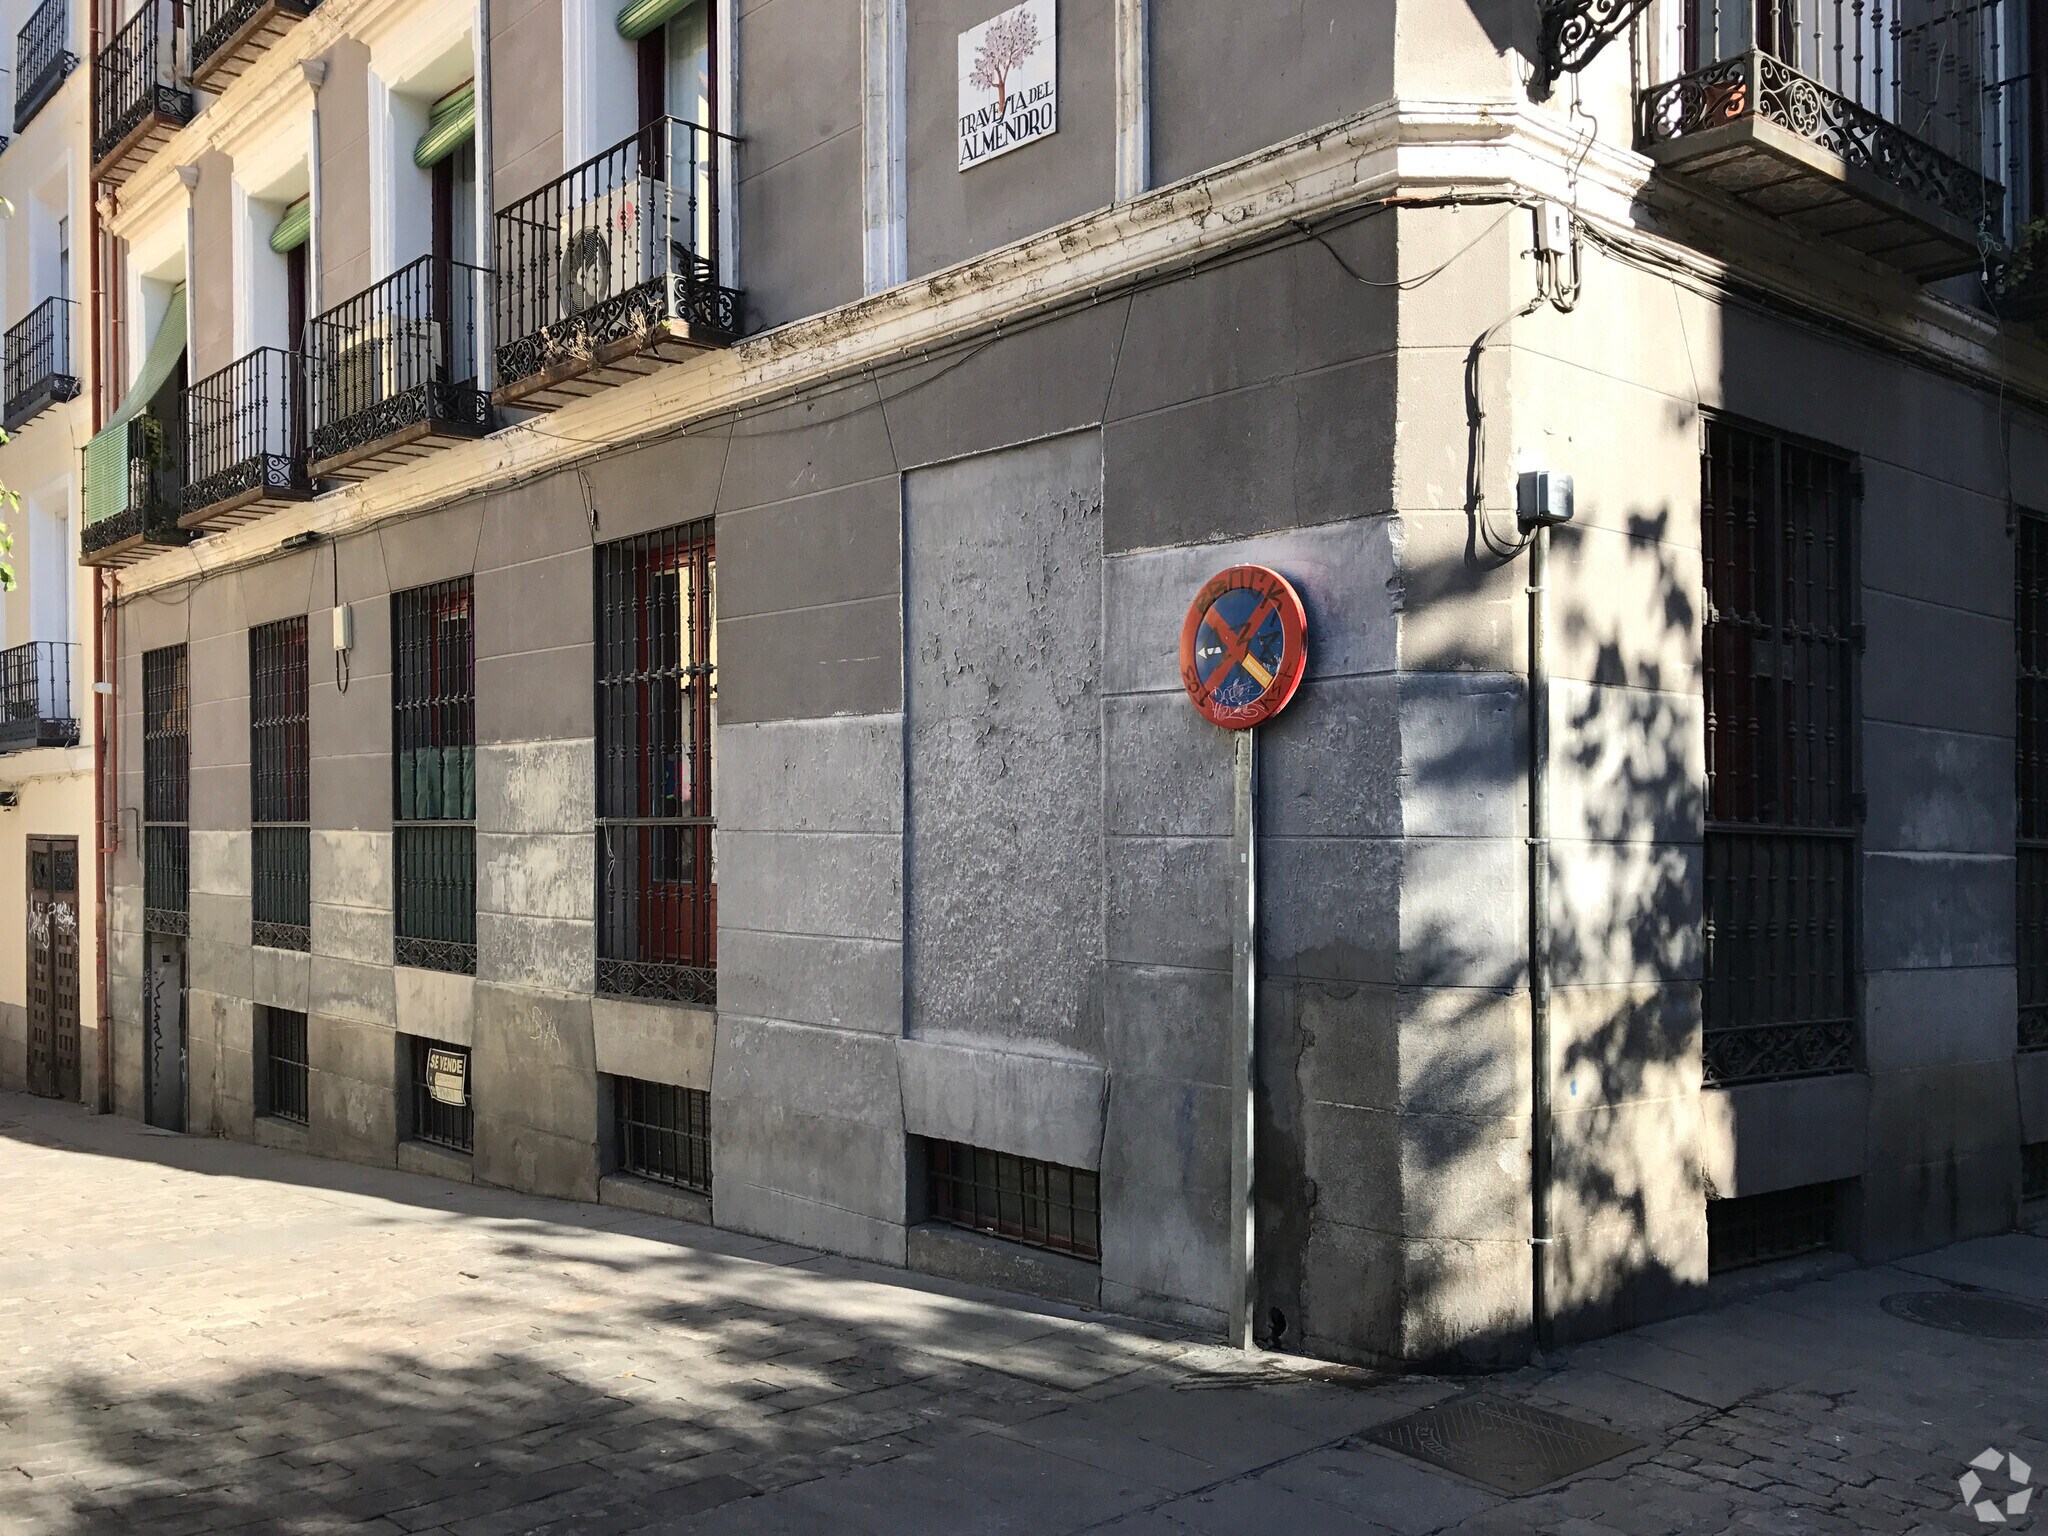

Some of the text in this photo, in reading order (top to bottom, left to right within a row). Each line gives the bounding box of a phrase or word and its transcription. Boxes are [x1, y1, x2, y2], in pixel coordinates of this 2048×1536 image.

[959, 81, 1054, 137] TRAVESIA DEL
[959, 102, 1053, 165] ALMENDRO
[430, 1053, 463, 1075] SE VENDE
